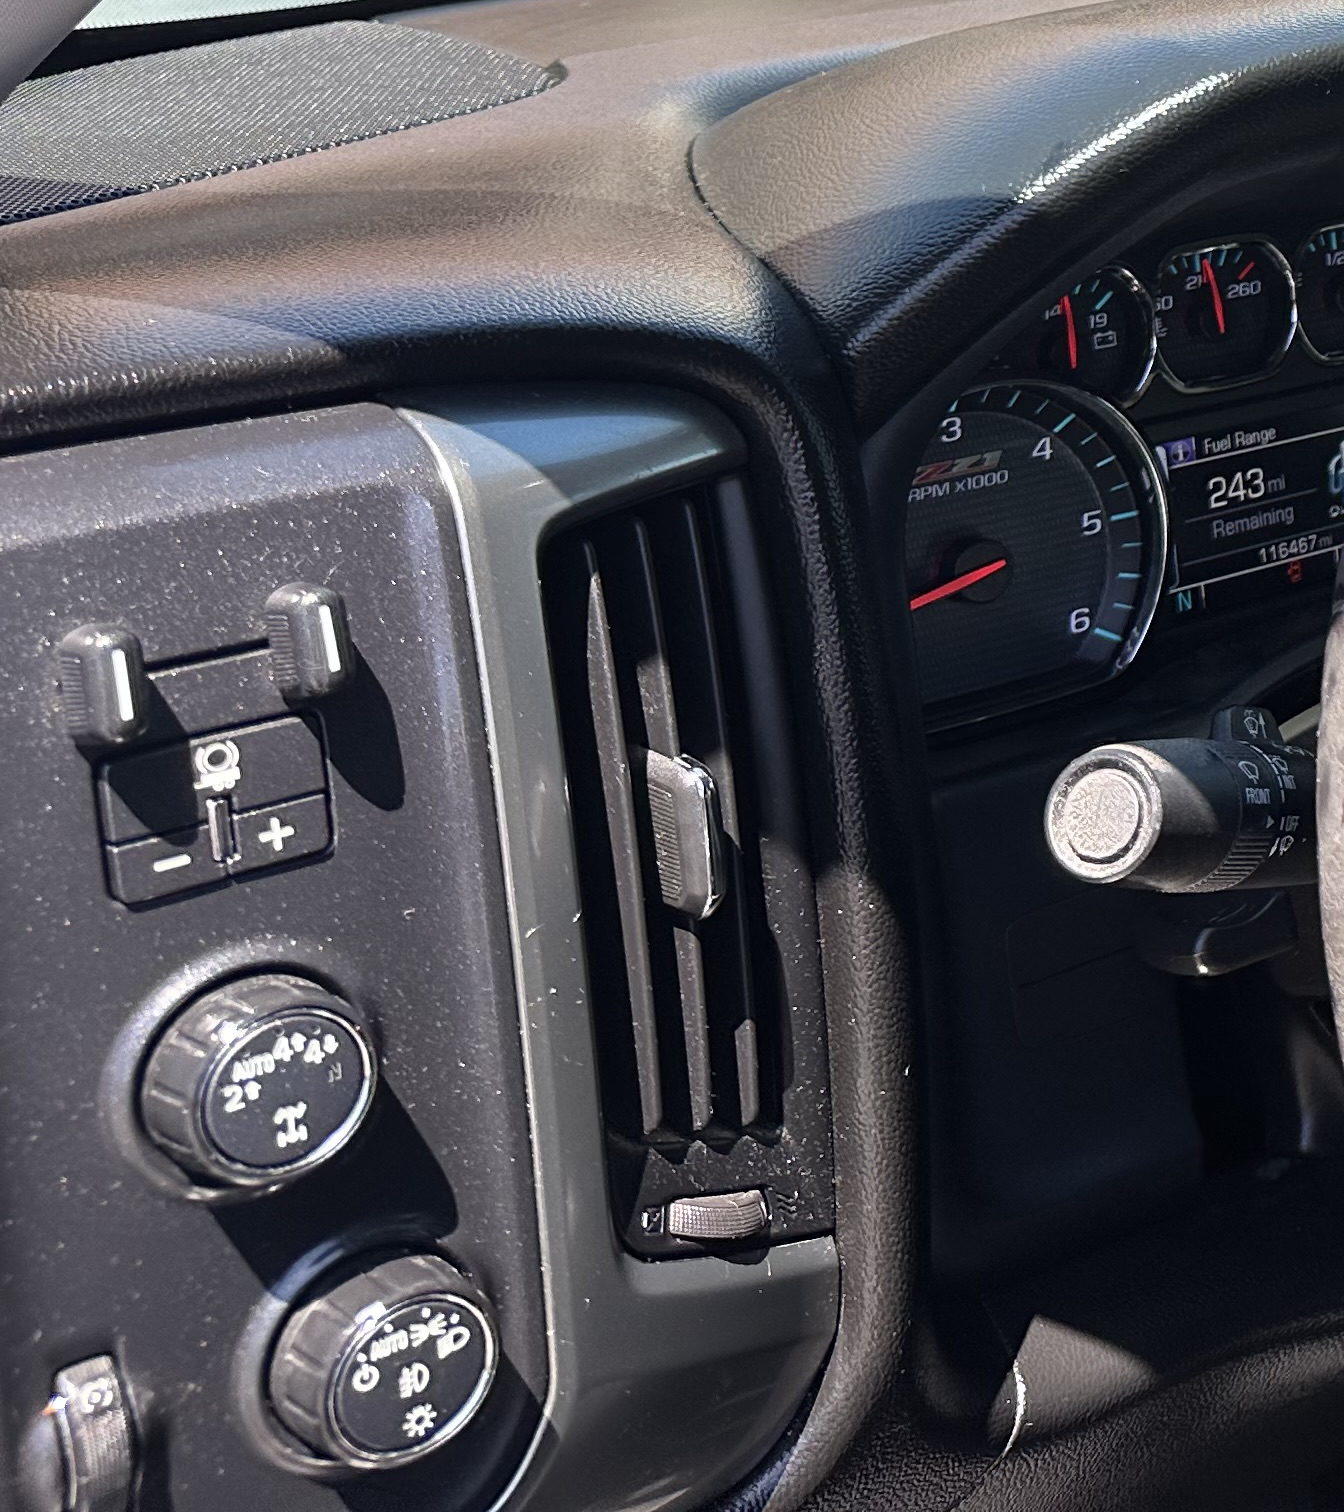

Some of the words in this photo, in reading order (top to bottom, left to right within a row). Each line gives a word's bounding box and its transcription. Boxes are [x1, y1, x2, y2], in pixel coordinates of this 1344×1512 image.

[1227, 280, 1262, 299] 260
[1089, 312, 1108, 329] 19
[941, 416, 962, 443] 3
[1203, 436, 1232, 455] Fuel
[1234, 427, 1277, 448] Range
[1031, 437, 1053, 461] 4
[908, 482, 951, 503] RPM
[1208, 468, 1265, 509] 243
[1081, 509, 1103, 536] 5
[1212, 506, 1295, 539] Remaining
[1259, 534, 1318, 563] 116467
[1176, 590, 1193, 613] N
[1070, 607, 1092, 634] 6
[1246, 787, 1272, 805] FRONT
[1286, 815, 1300, 832] OFF
[229, 1051, 276, 1083] AUTO
[369, 1330, 409, 1361] AUTO
